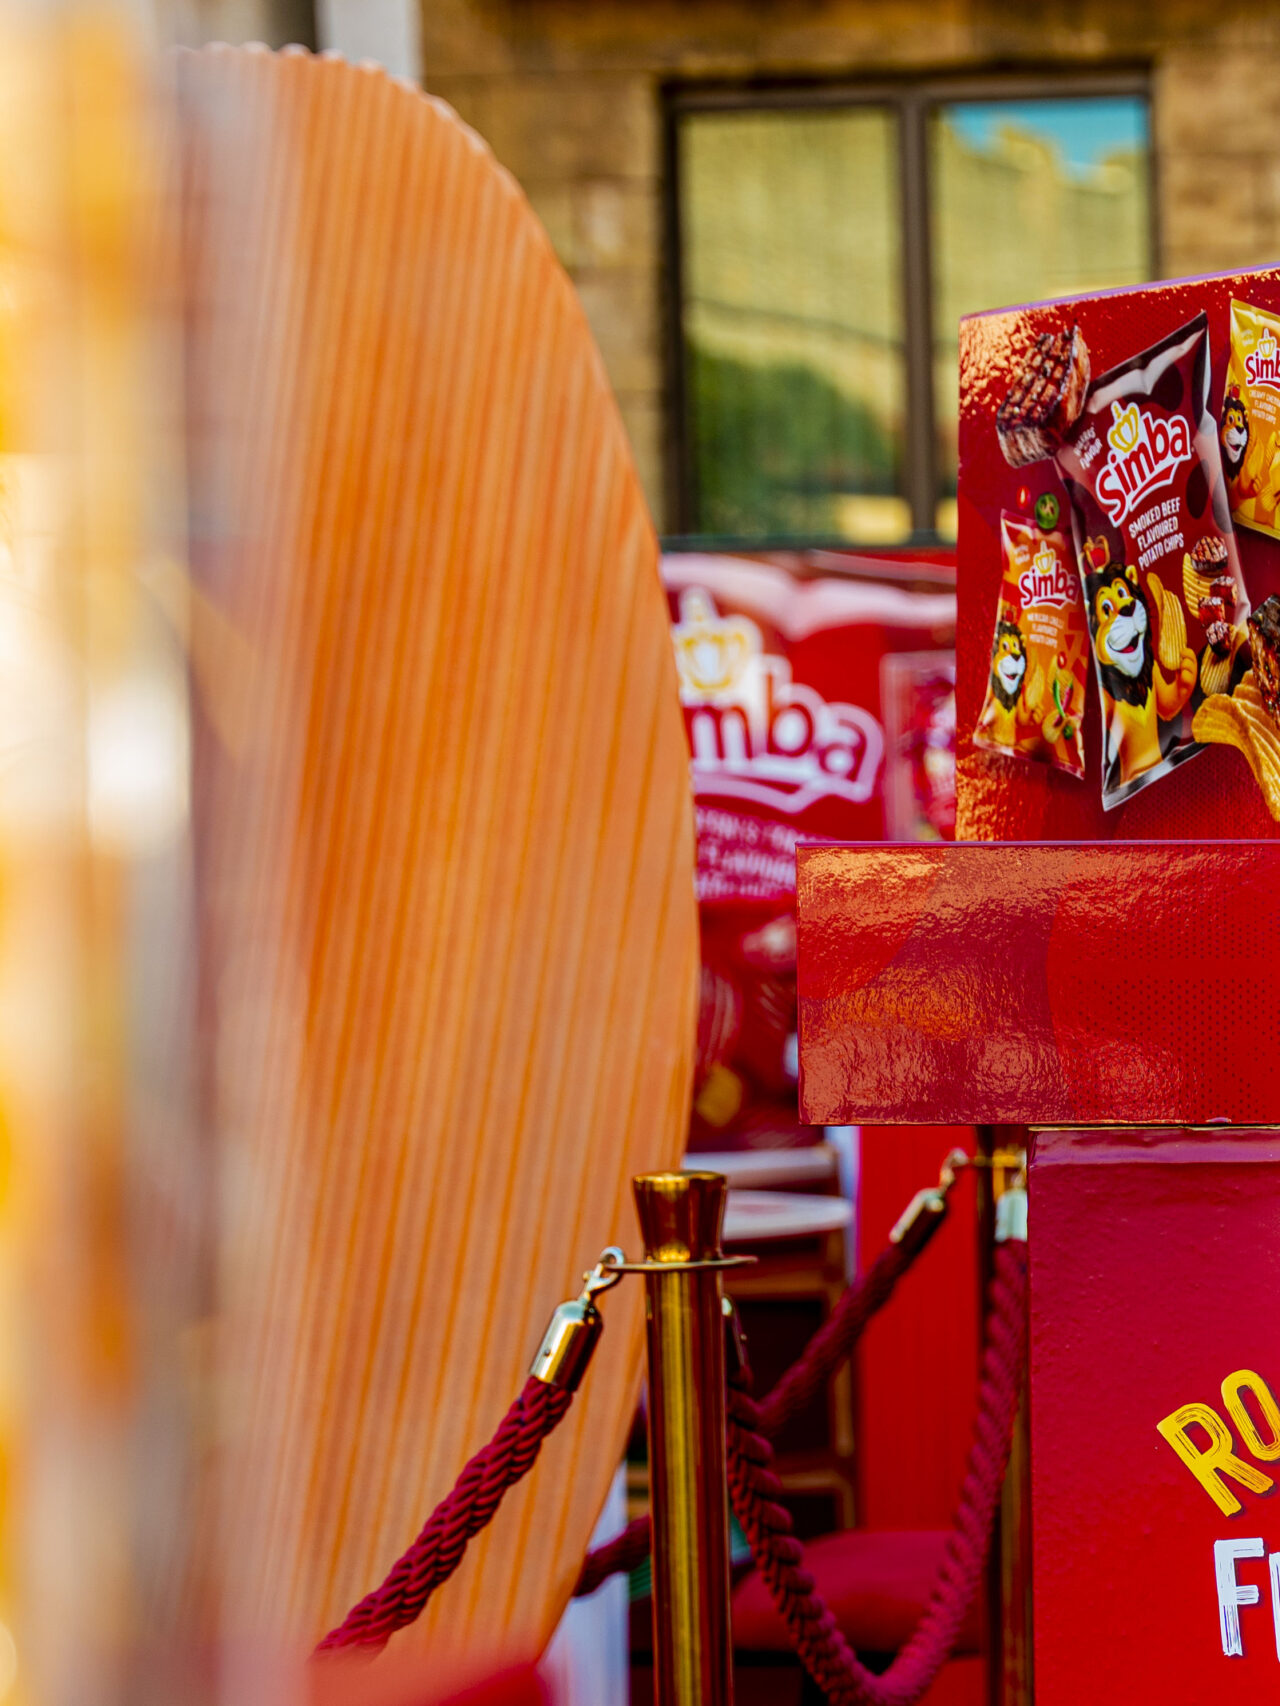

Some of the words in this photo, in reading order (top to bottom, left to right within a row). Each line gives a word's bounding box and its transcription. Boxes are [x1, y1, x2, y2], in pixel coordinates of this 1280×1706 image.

[1096, 406, 1191, 528] Simba
[1129, 505, 1161, 539] SMOKED
[1161, 496, 1181, 517] BEEF
[1137, 516, 1178, 552] FLAVOURED
[1138, 541, 1164, 571] POTATO
[1164, 532, 1184, 554] CHIPS
[1019, 560, 1079, 609] Simba
[690, 655, 885, 803] mba
